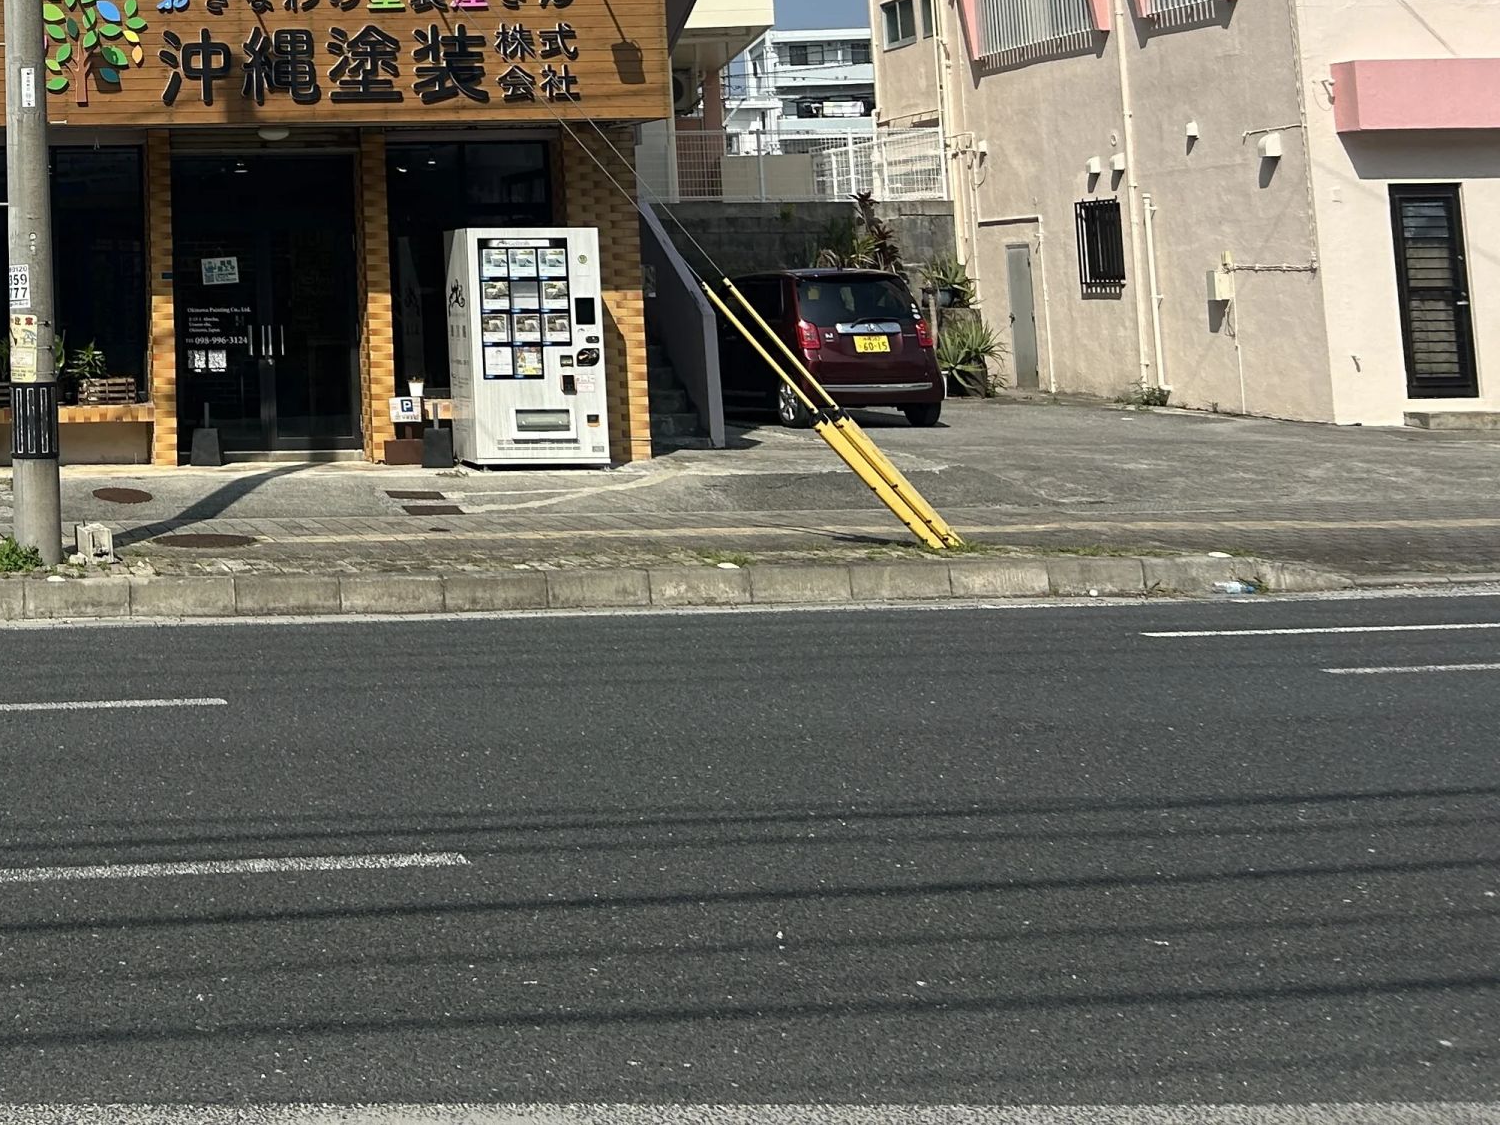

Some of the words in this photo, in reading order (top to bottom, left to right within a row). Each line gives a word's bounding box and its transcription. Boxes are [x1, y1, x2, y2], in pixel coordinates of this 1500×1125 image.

[494, 22, 579, 61] 株式
[158, 23, 490, 106] 沖縄塗装
[497, 63, 581, 102] 会社
